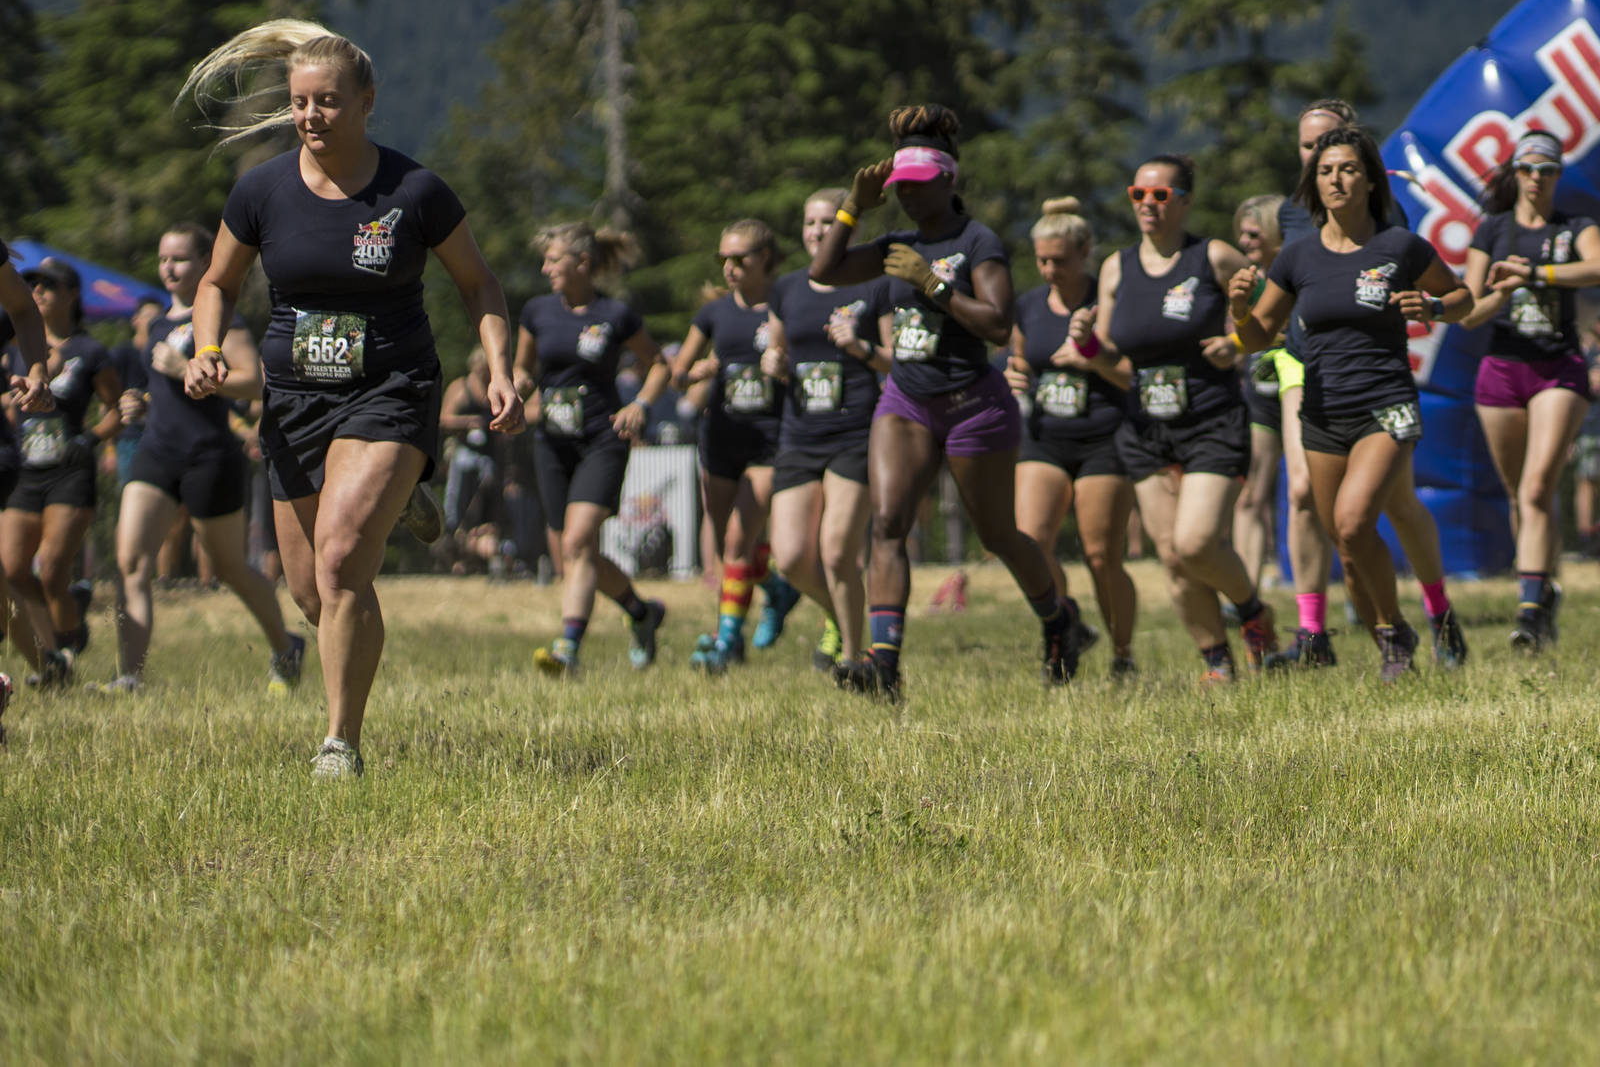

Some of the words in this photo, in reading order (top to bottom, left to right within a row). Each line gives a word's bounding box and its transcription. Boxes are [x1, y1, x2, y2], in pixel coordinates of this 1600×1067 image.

[353, 234, 375, 246] Red
[376, 234, 395, 246] Bull
[354, 245, 390, 259] 400
[307, 334, 348, 364] 552
[304, 364, 352, 374] WHISTLER
[1388, 405, 1414, 428] 21
